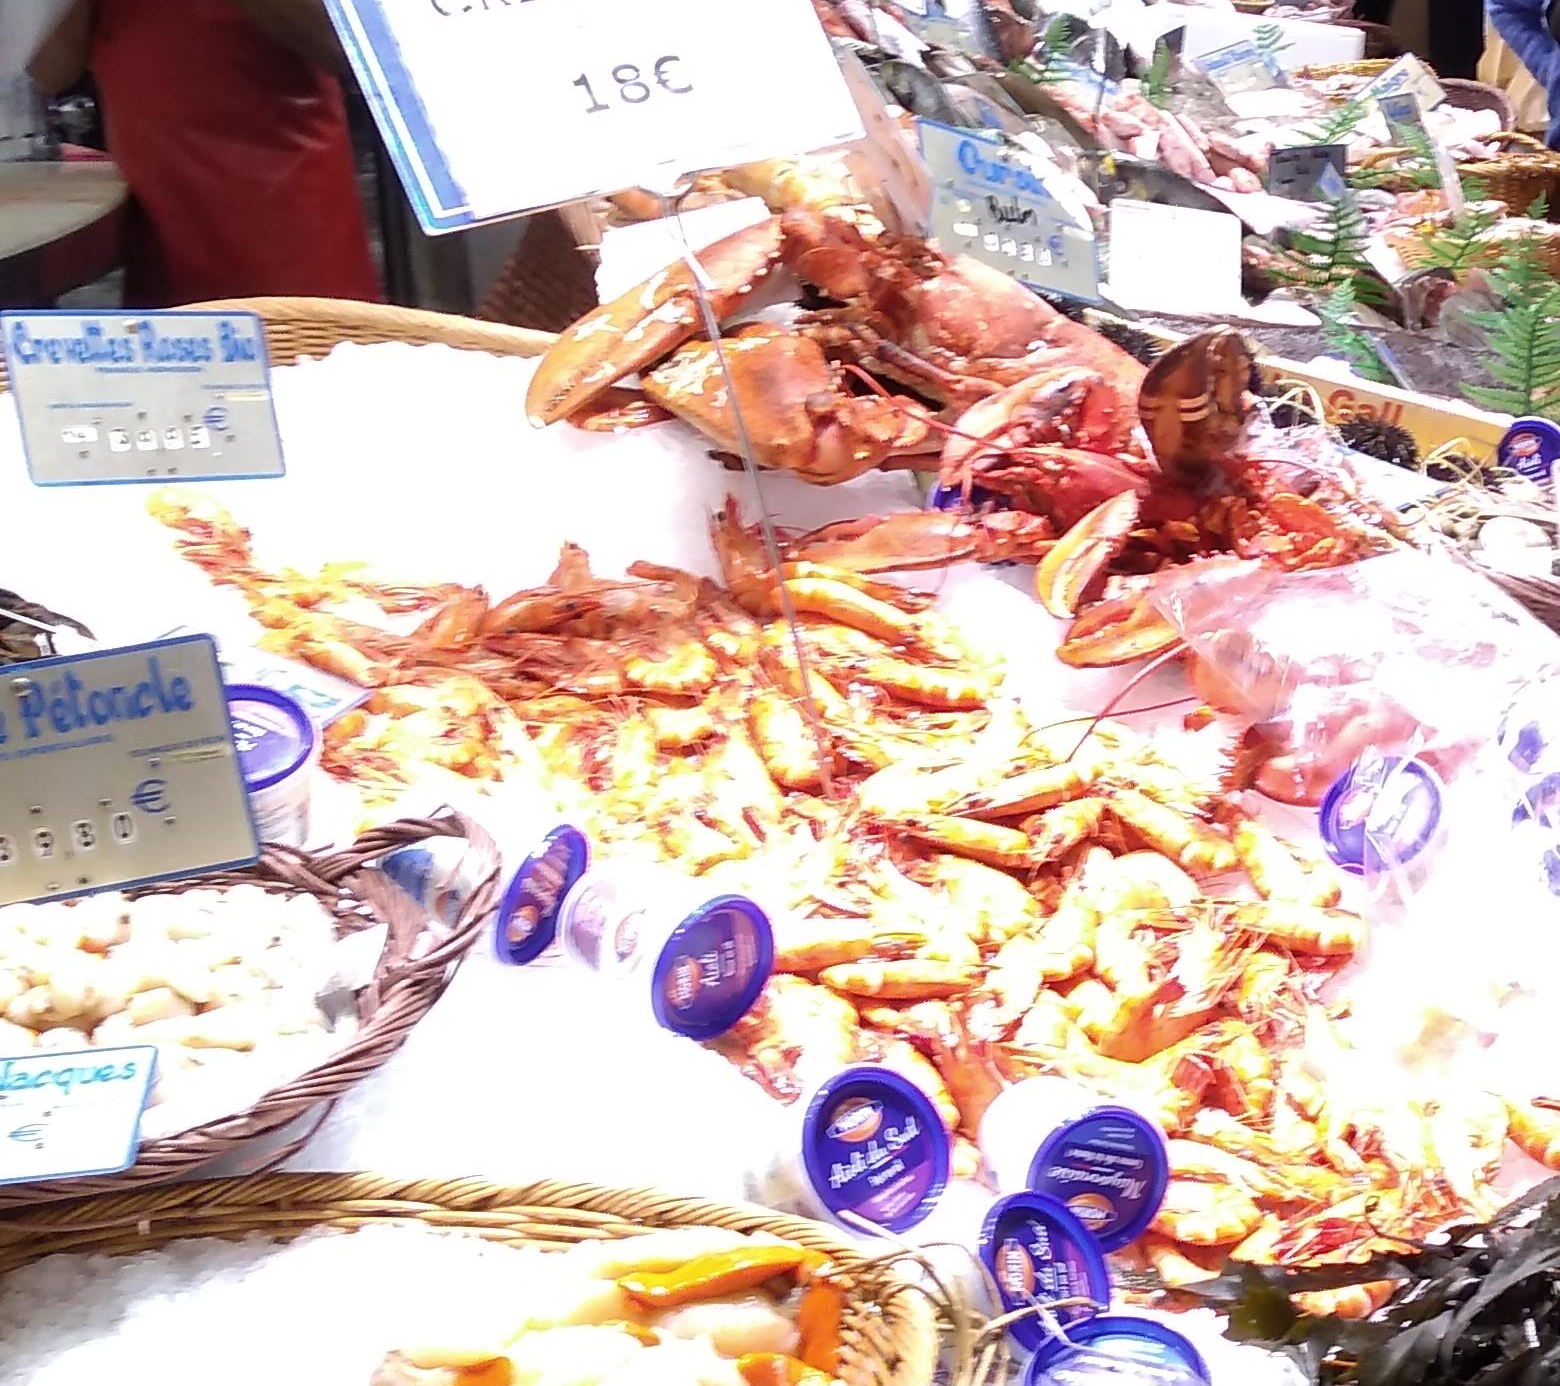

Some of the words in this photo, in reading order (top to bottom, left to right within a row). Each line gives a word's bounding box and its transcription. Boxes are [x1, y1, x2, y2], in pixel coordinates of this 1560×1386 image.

[573, 55, 694, 114] 18€
[11, 321, 134, 364] Crevettes
[139, 320, 214, 363] Roses
